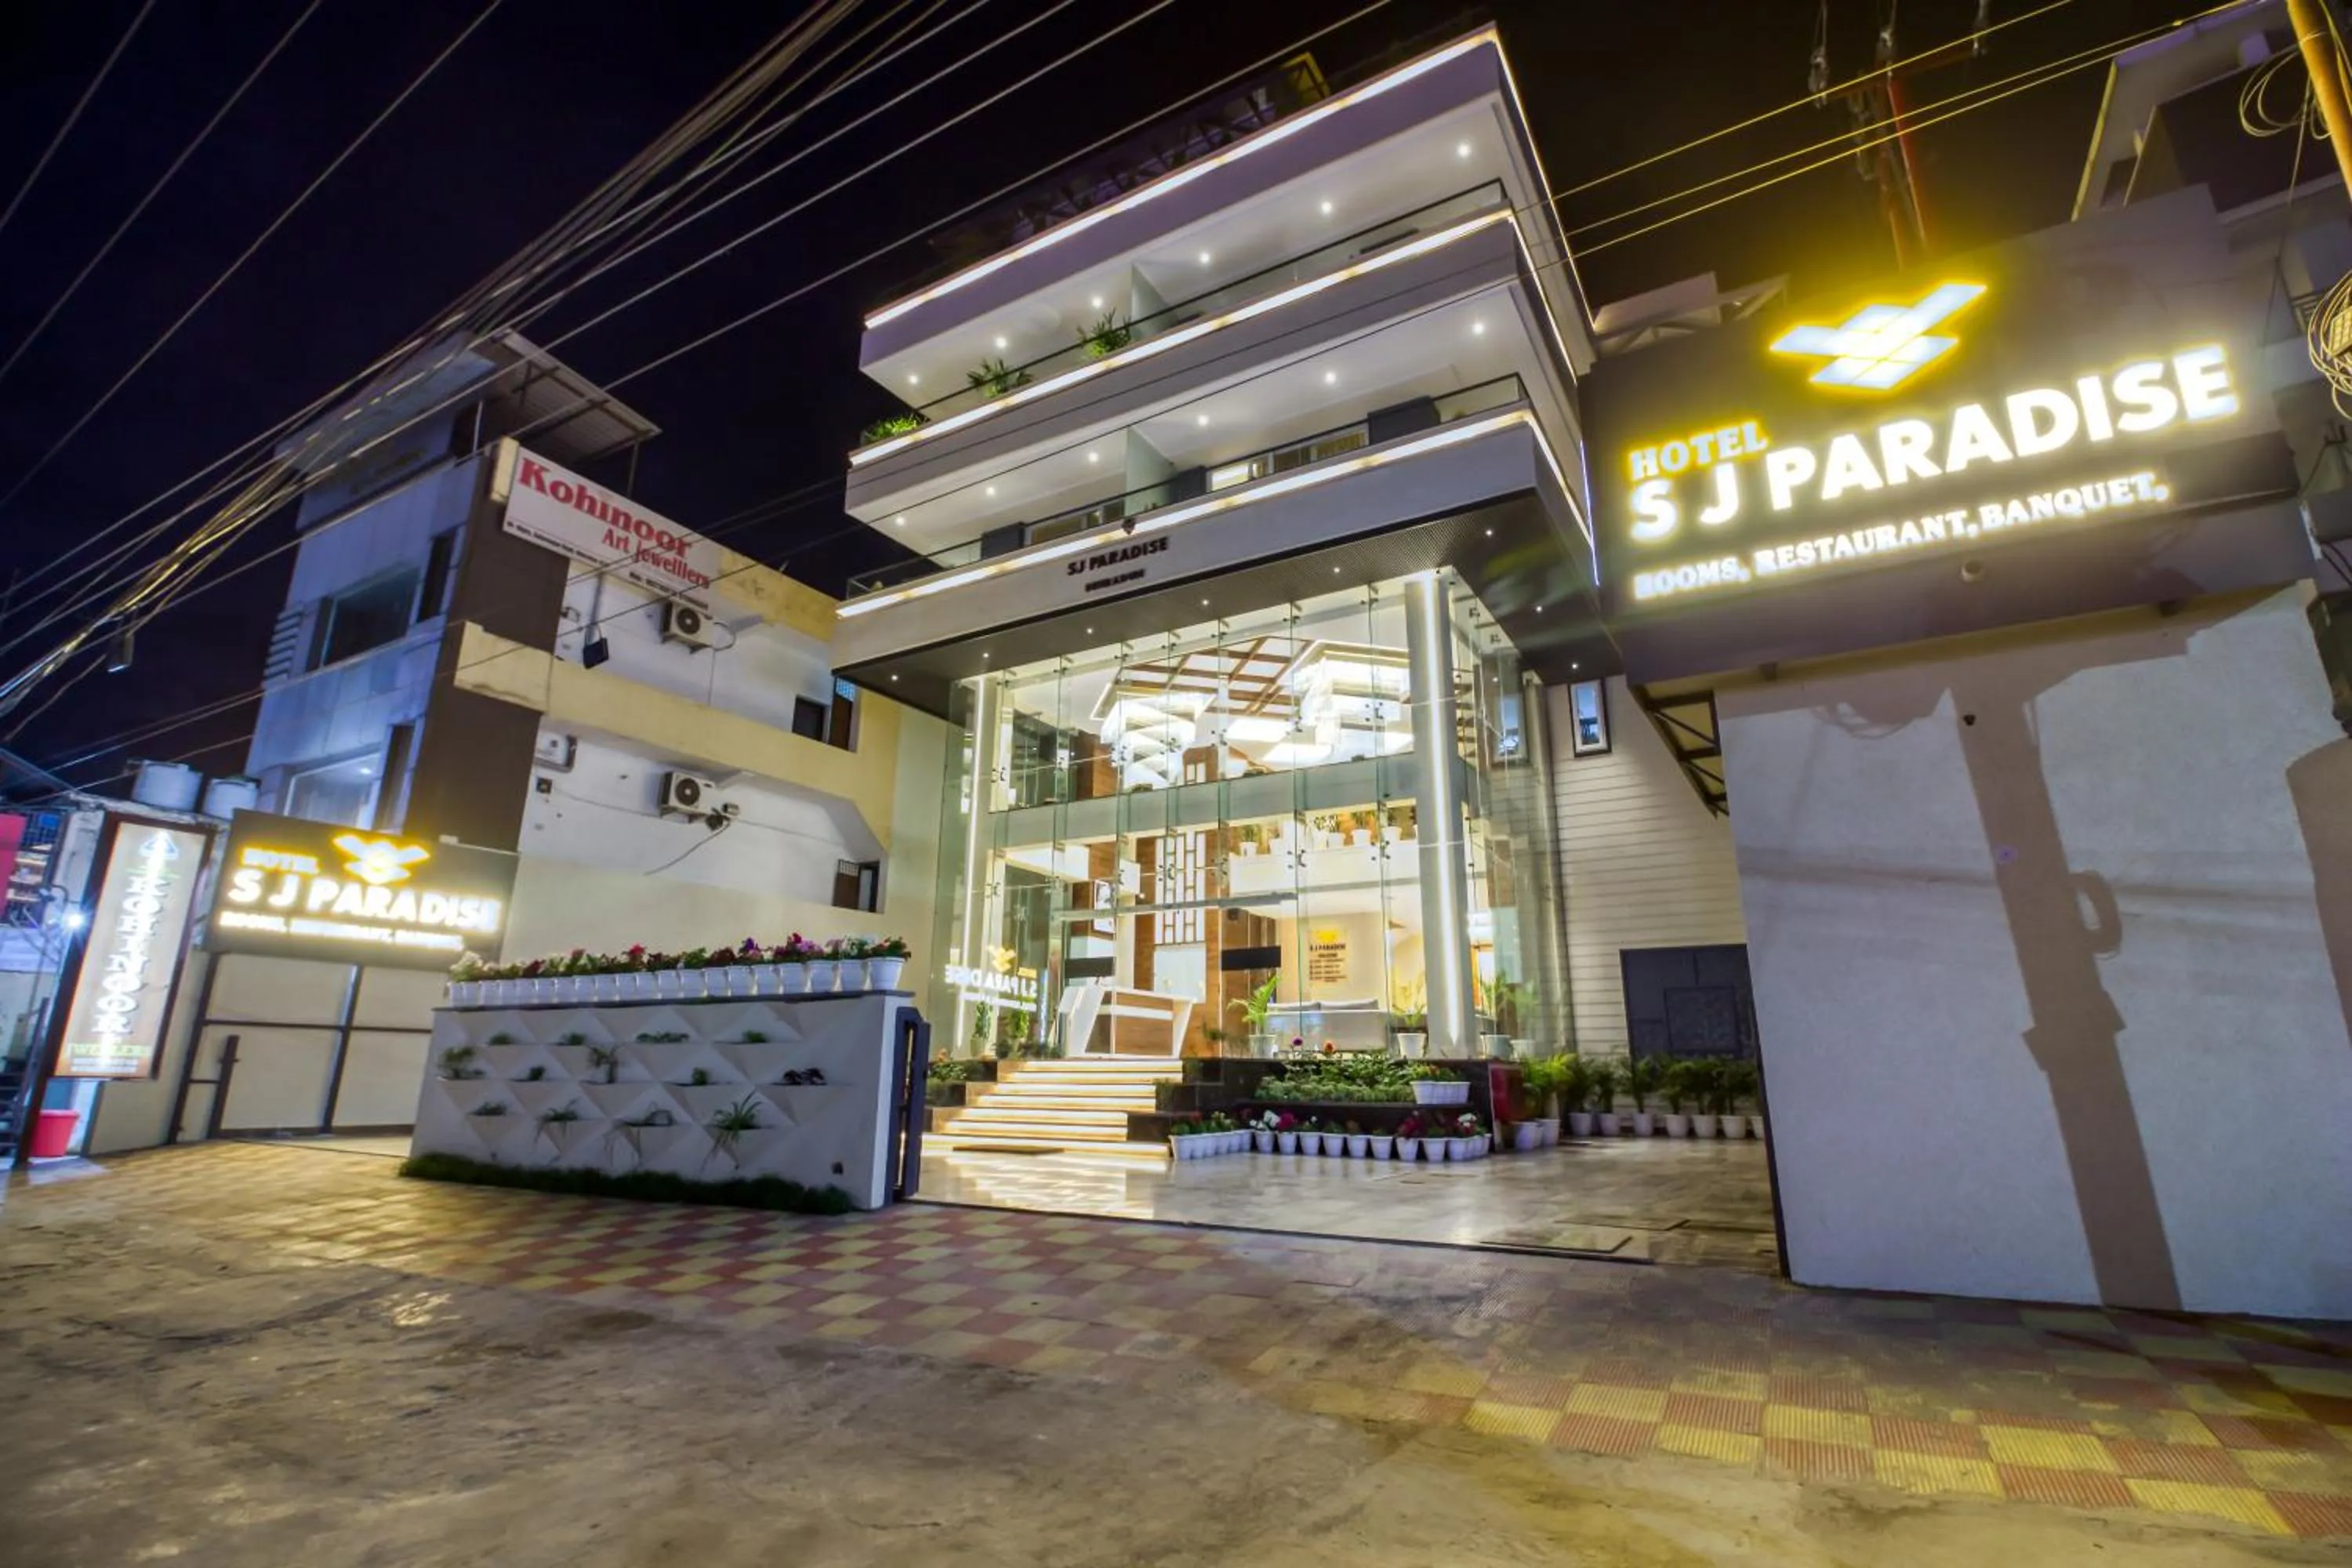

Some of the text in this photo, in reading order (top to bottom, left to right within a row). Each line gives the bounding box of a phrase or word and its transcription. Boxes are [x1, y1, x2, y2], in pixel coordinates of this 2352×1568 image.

[1630, 422, 1768, 481] HOTEL
[1631, 343, 2239, 539] S J PARADISE
[520, 458, 690, 557] Kohinoor
[603, 528, 630, 552] Art
[227, 868, 264, 903] S
[267, 873, 300, 908] J
